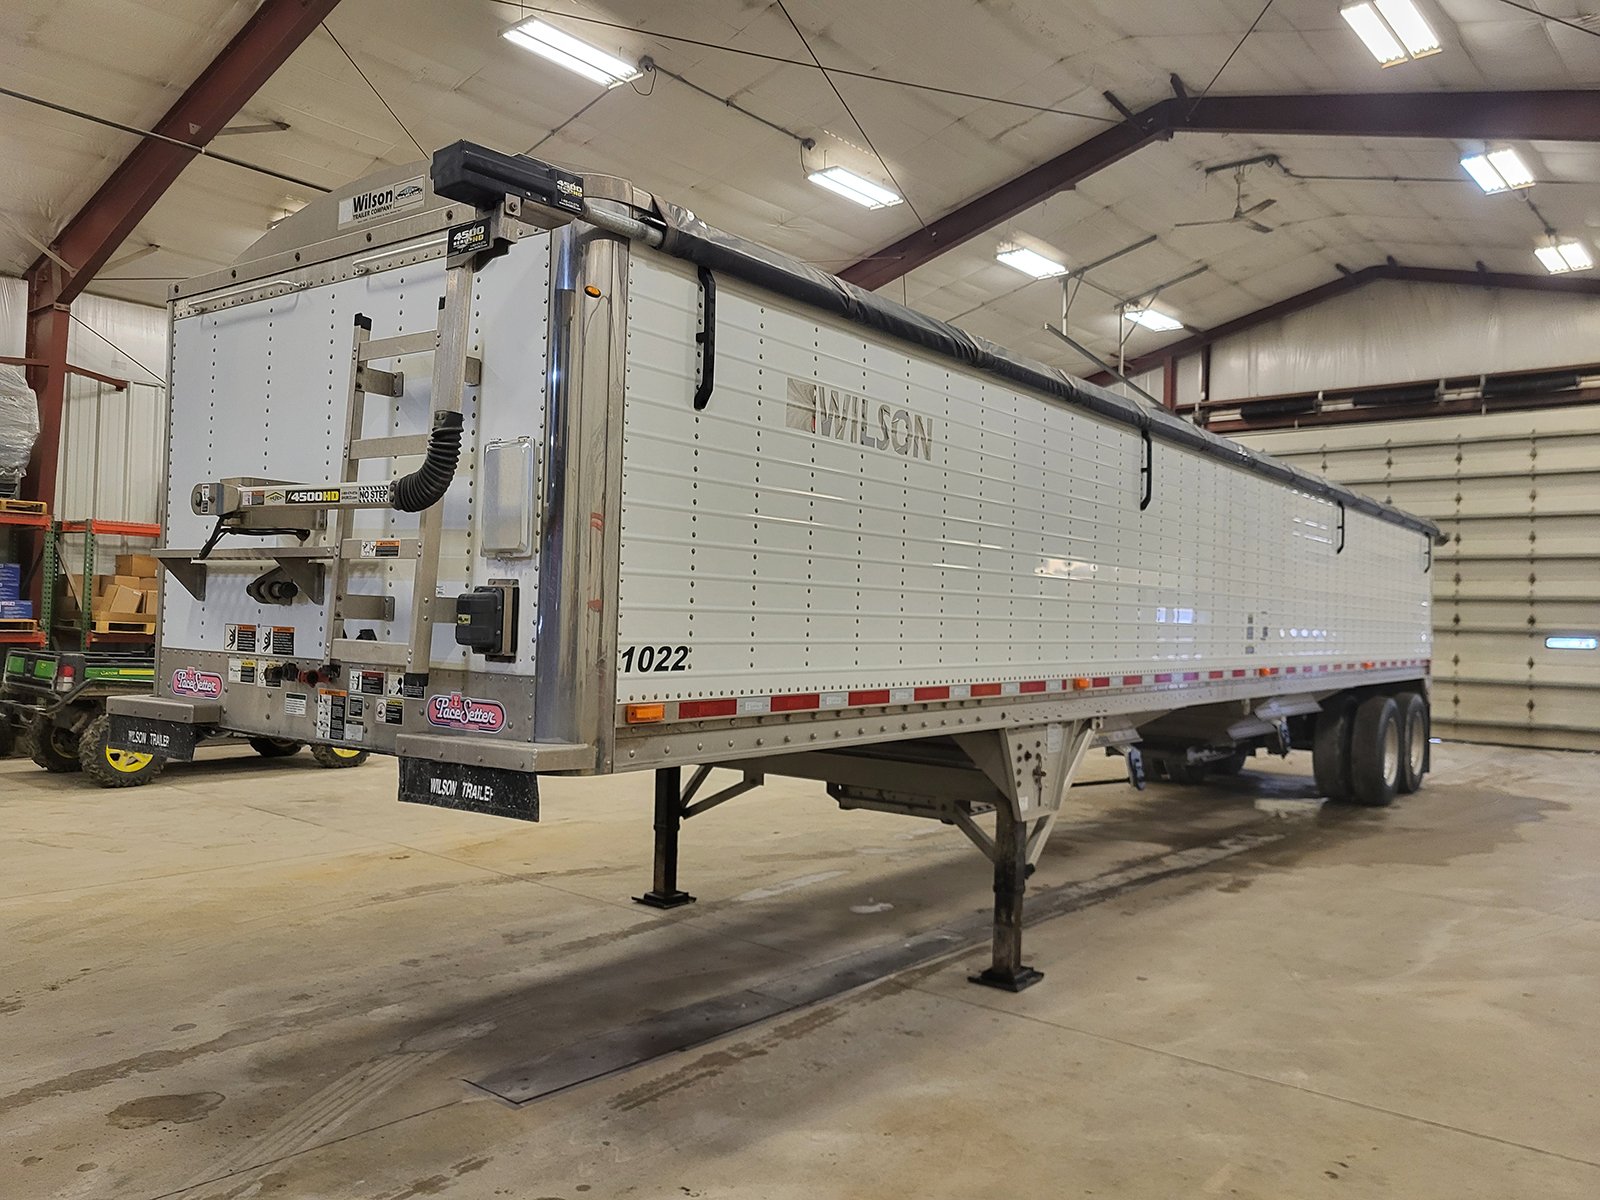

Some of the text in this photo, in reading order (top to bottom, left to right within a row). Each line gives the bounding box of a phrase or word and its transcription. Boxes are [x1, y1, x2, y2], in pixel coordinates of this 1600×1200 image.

[556, 179, 583, 193] 4500
[352, 189, 393, 213] Wilson
[352, 200, 371, 221] TRAILER
[370, 203, 393, 216] COMPANY
[453, 225, 485, 241] 4500
[818, 385, 933, 461] WILSON
[359, 490, 370, 499] NO
[370, 489, 388, 499] STEP
[621, 645, 689, 673] 1022
[149, 732, 170, 747] TRAILER
[430, 777, 458, 797] WILSON
